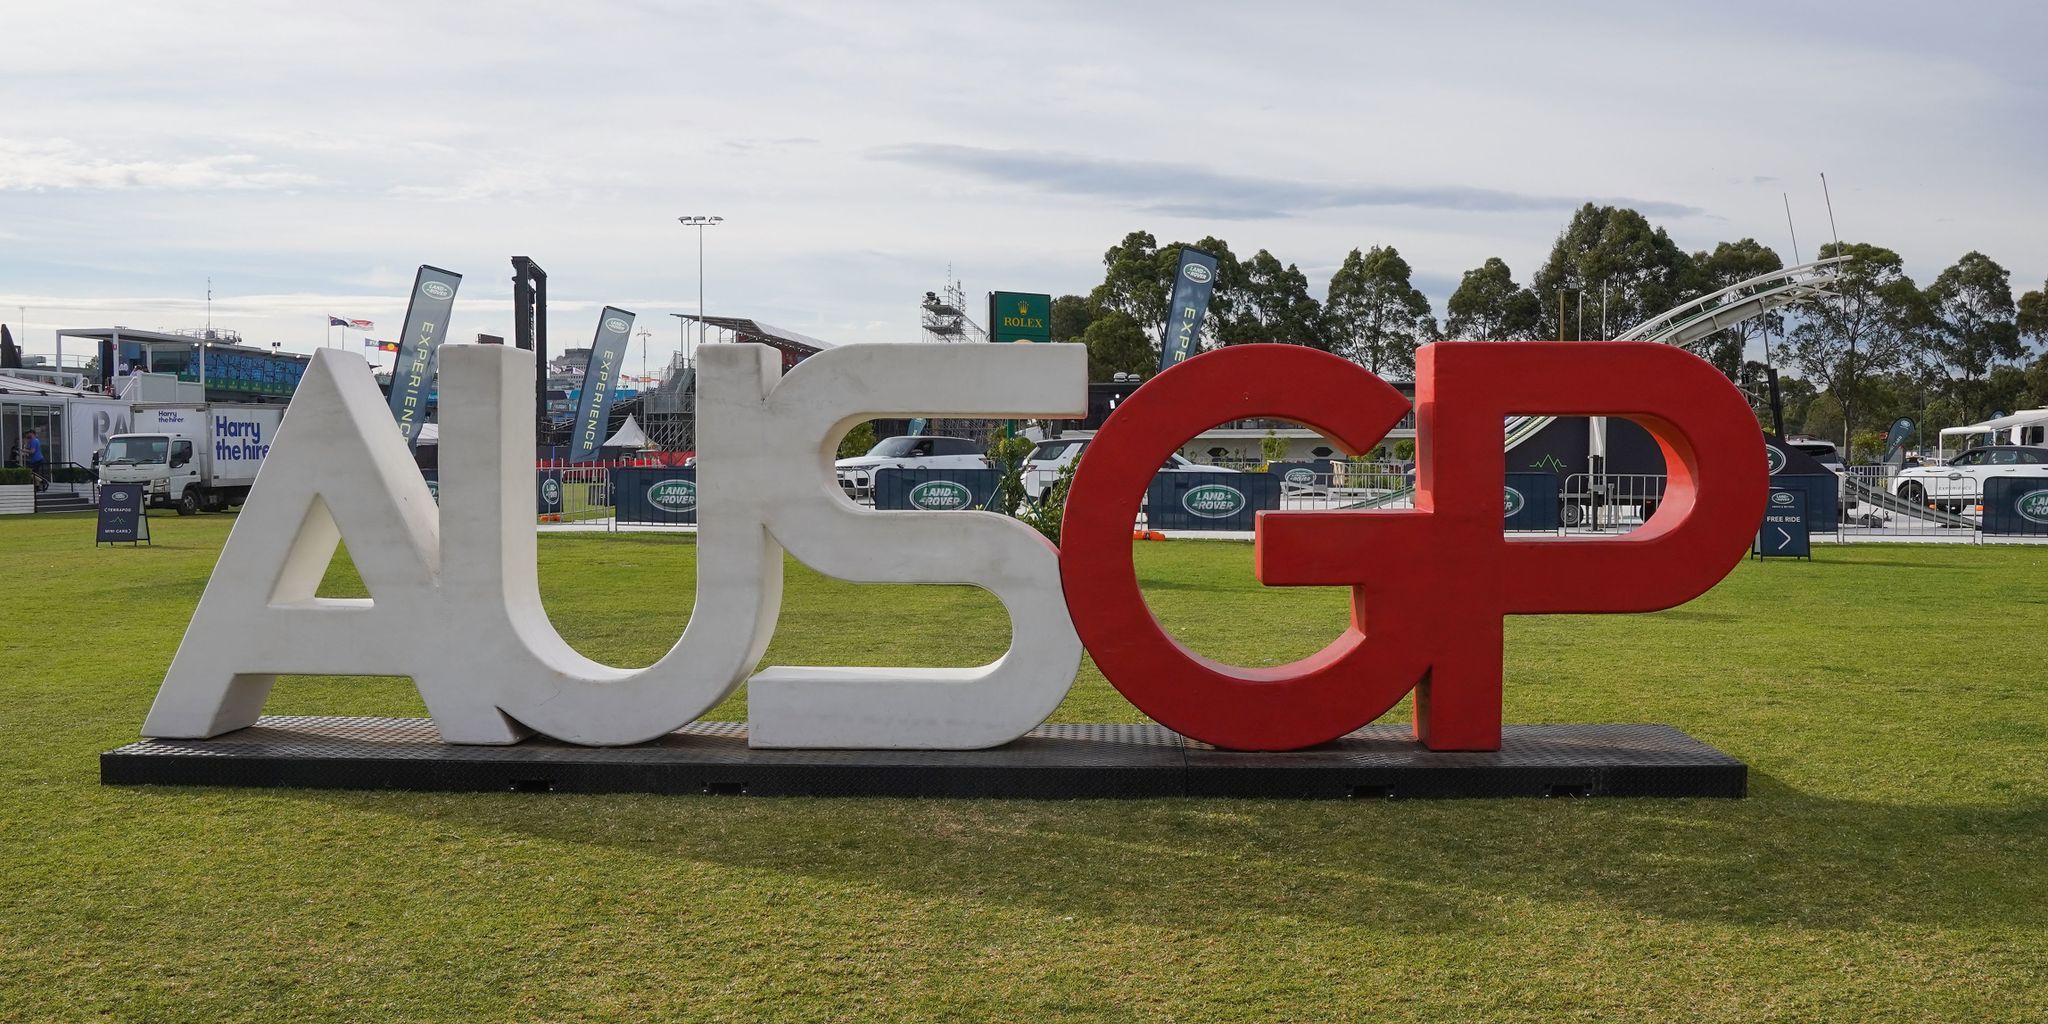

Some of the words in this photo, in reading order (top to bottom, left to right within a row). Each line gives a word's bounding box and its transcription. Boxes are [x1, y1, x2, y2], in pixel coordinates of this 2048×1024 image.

[1189, 266, 1204, 274] LAND
[1190, 271, 1207, 280] ROVER
[1004, 317, 1042, 328] ROLEX
[583, 350, 614, 450] EXPERIENCE
[216, 416, 260, 444] Harry
[216, 439, 241, 460] the
[659, 487, 687, 495] LAND
[923, 488, 953, 497] LAND
[661, 495, 696, 504] ROVER
[1196, 492, 1224, 501] LAND
[924, 497, 960, 506] ROVER
[1198, 501, 1233, 510] ROVER
